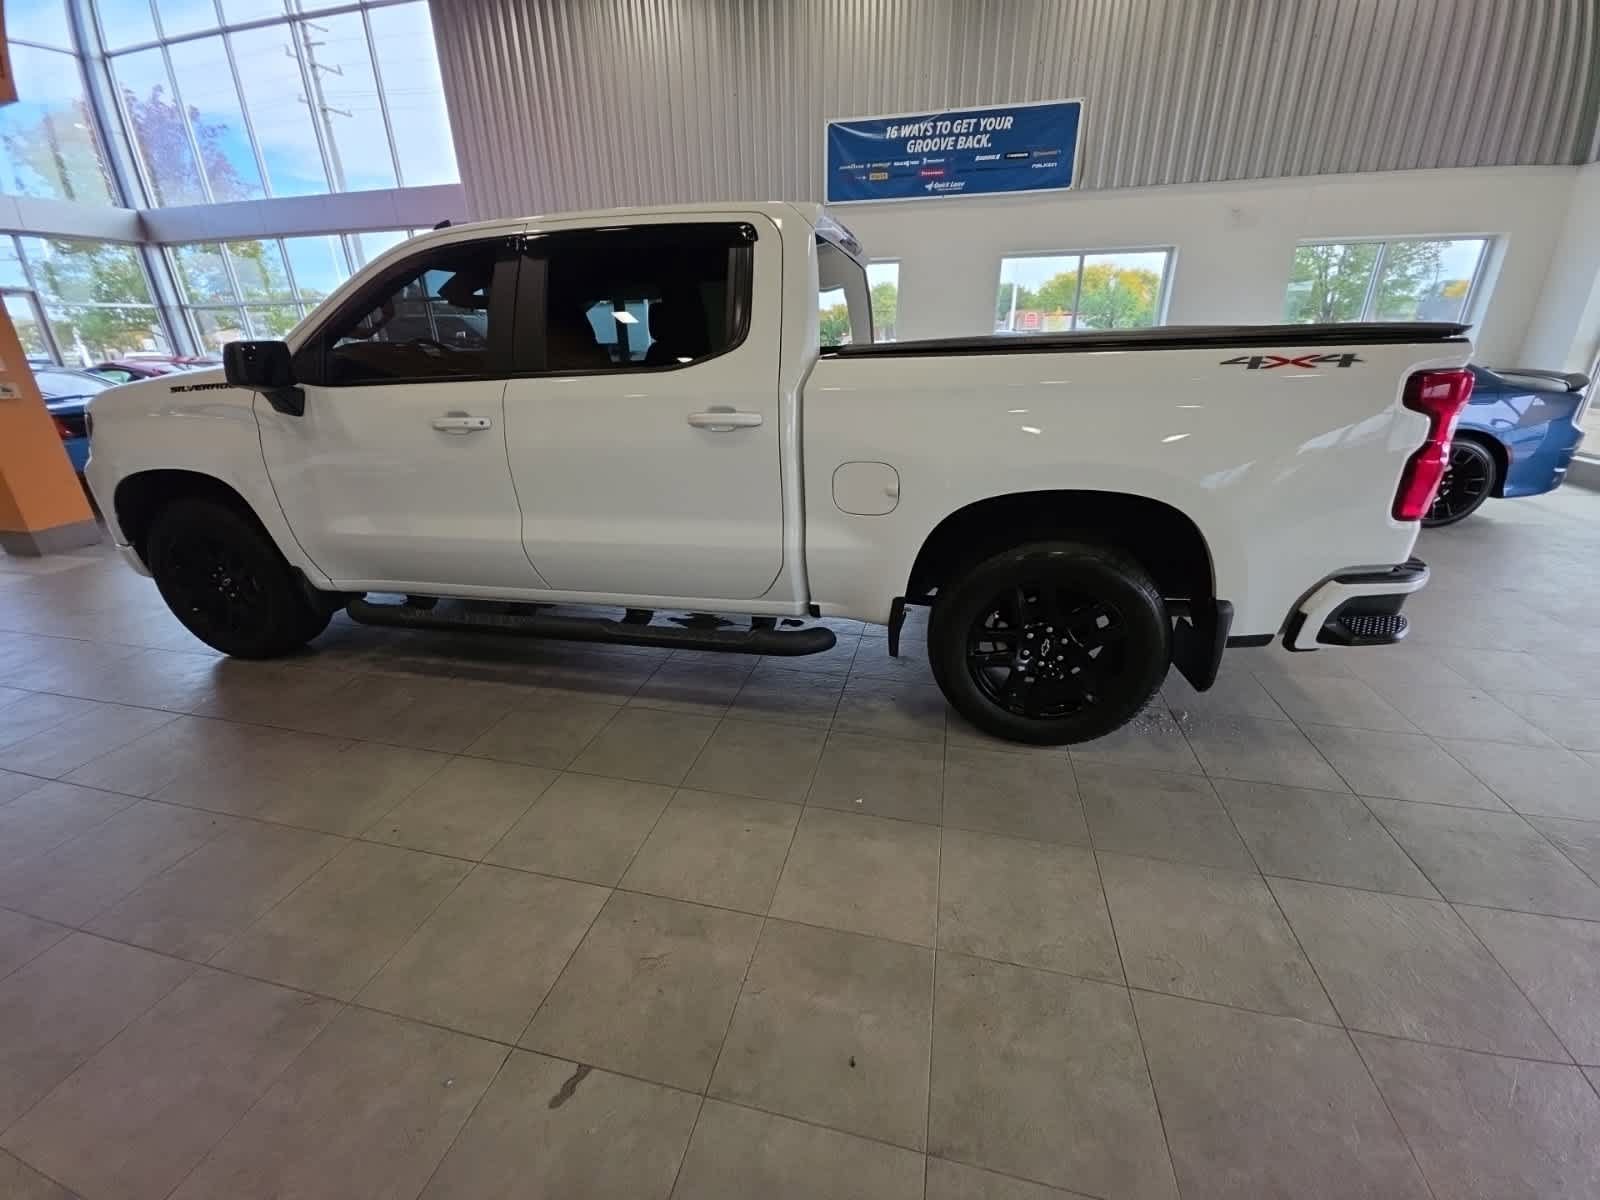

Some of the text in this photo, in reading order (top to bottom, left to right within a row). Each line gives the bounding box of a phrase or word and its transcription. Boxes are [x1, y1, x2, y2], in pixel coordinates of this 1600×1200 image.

[885, 116, 1014, 139] 16 WAYS TO GET YOUR
[906, 134, 992, 153] GROOVE BACK.
